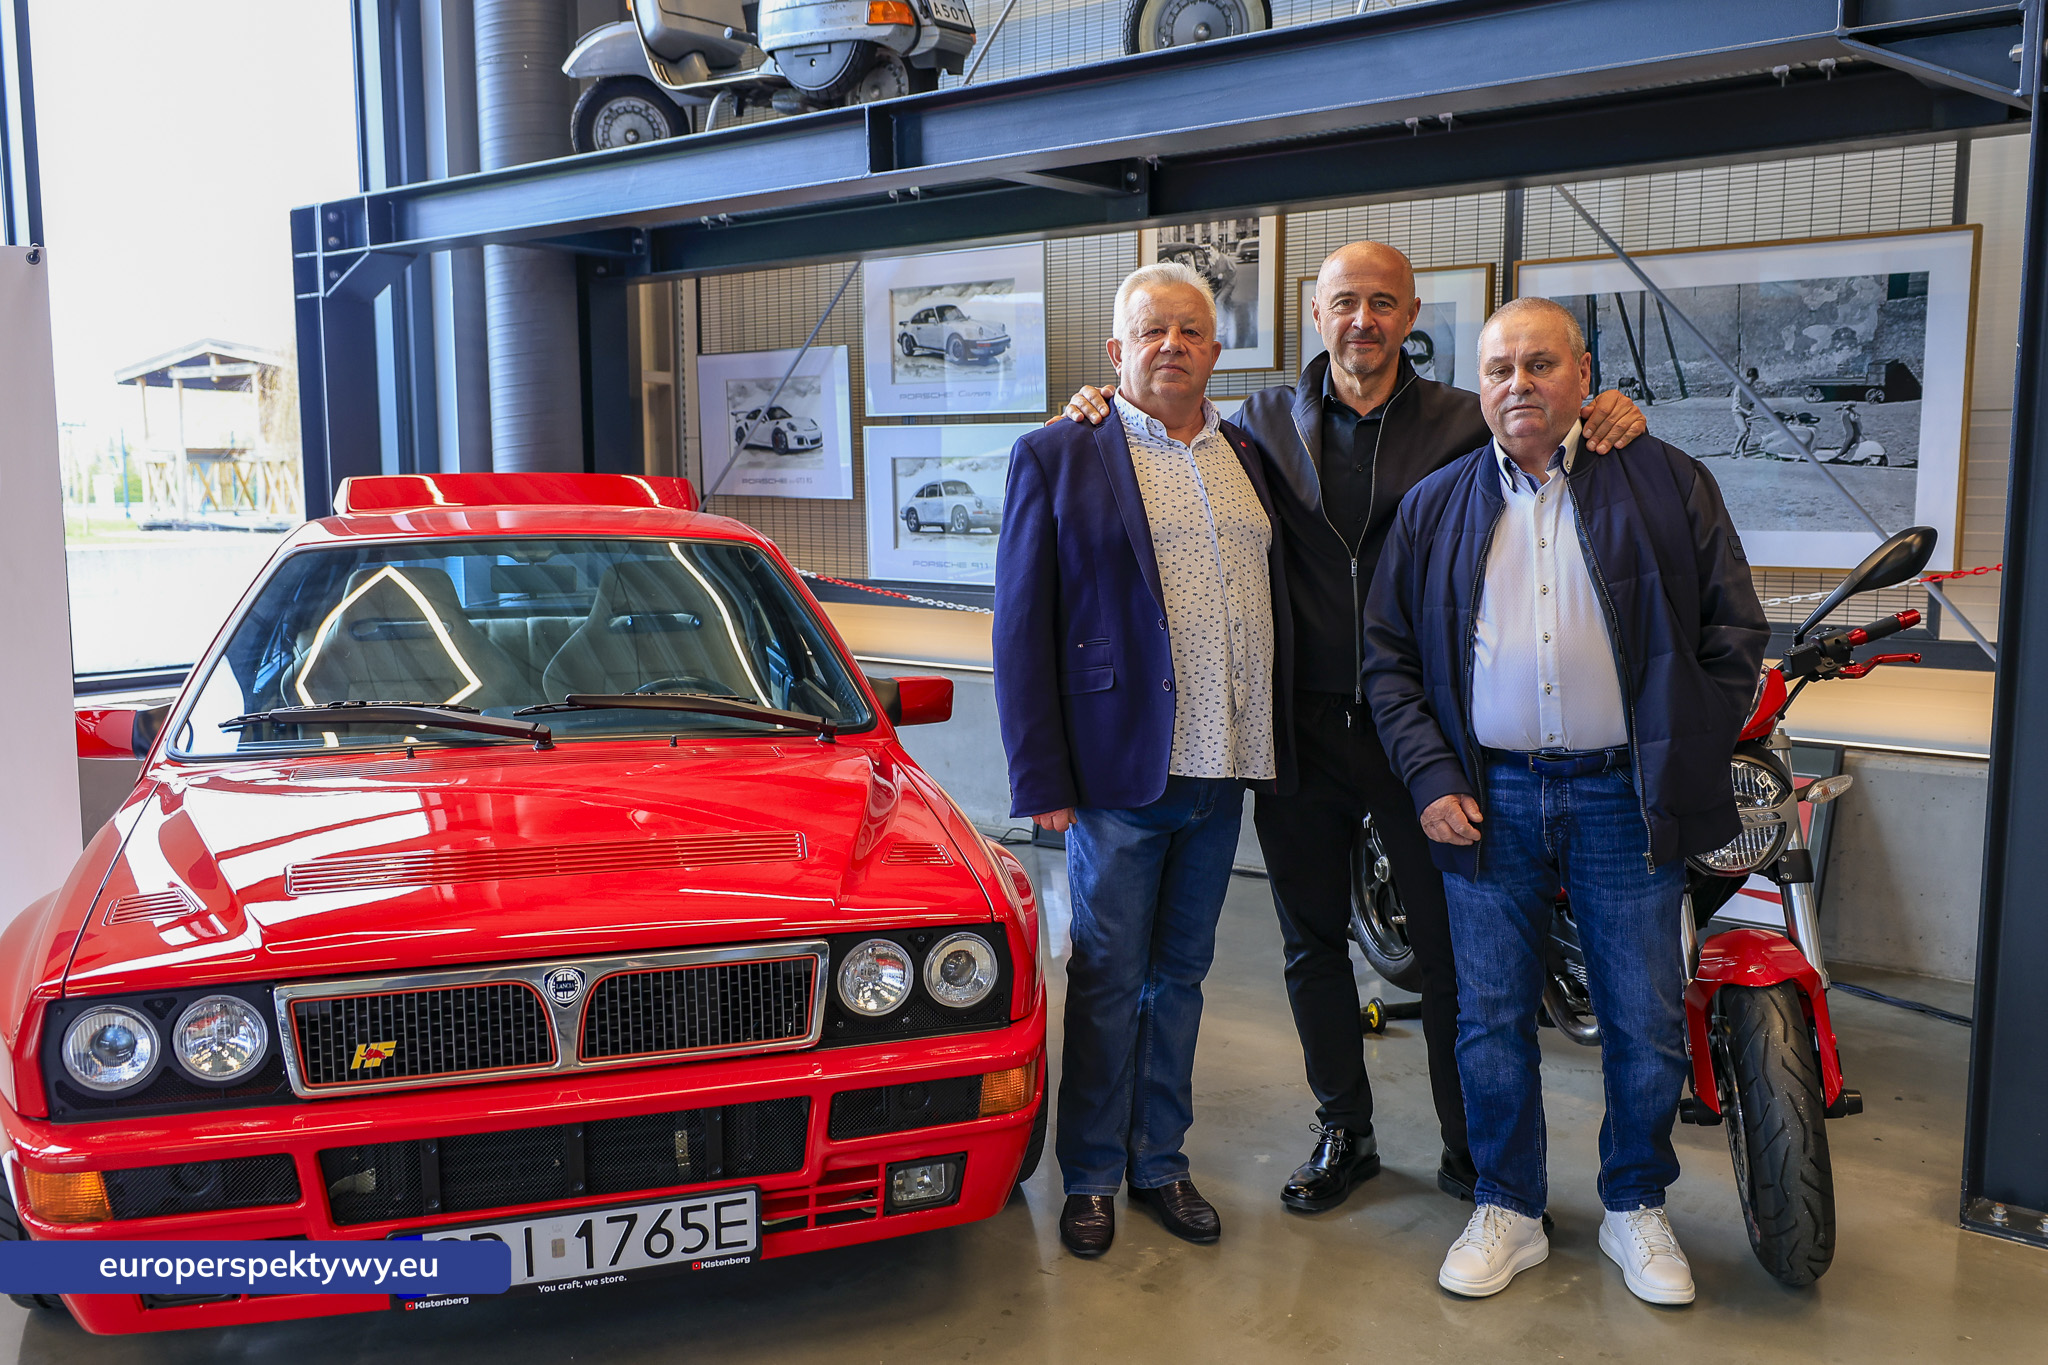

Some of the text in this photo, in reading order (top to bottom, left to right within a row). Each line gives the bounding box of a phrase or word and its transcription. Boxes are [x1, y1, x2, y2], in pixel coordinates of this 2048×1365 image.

[899, 391, 954, 400] PORSCHE
[912, 560, 967, 568] PORSCHE
[556, 982, 575, 990] LANCIA
[350, 1040, 397, 1070] HF
[574, 1198, 748, 1269] 1765E
[701, 1256, 751, 1269] Kistenberg
[538, 1275, 627, 1293] You craft, we store.
[414, 1296, 470, 1310] Kistenberg
